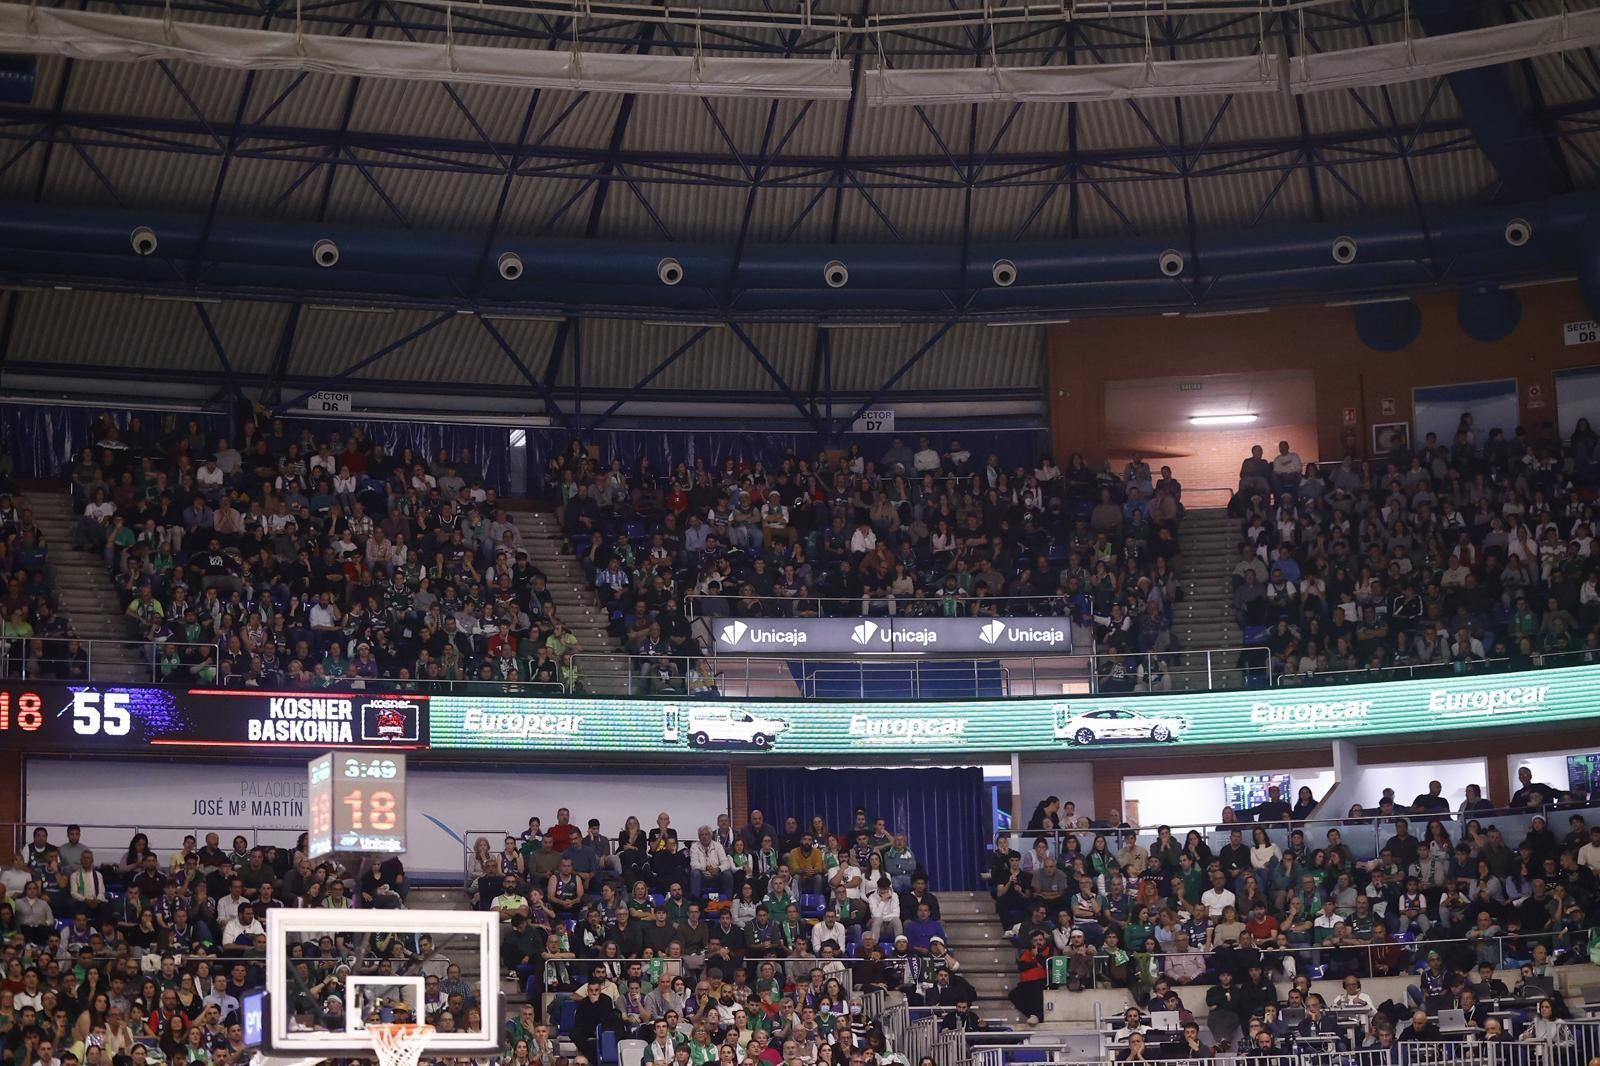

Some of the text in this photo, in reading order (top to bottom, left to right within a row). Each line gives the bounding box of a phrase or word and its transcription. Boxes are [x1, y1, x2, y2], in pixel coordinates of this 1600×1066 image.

[1567, 322, 1600, 332] SECTO
[1579, 331, 1596, 342] D8
[312, 392, 349, 401] SECTOR
[322, 402, 338, 411] D6
[861, 411, 892, 419] ECTOR
[866, 421, 882, 430] D7
[750, 629, 807, 646] Unicaja
[880, 628, 937, 646] Unicaja
[1008, 628, 1064, 646] Unicaja
[269, 698, 352, 720] KOSNER
[1429, 685, 1550, 715] Europcar
[73, 692, 130, 735] 55
[1250, 700, 1372, 727] Europcar
[248, 719, 352, 742] BASKONIA
[463, 707, 584, 739] Europcar
[849, 714, 968, 742] Europcar
[345, 759, 397, 778] 3:49
[241, 781, 292, 798] PALACIO
[192, 797, 223, 816] JOSÉ
[252, 798, 303, 817] MARTÍN
[344, 789, 396, 830] 18
